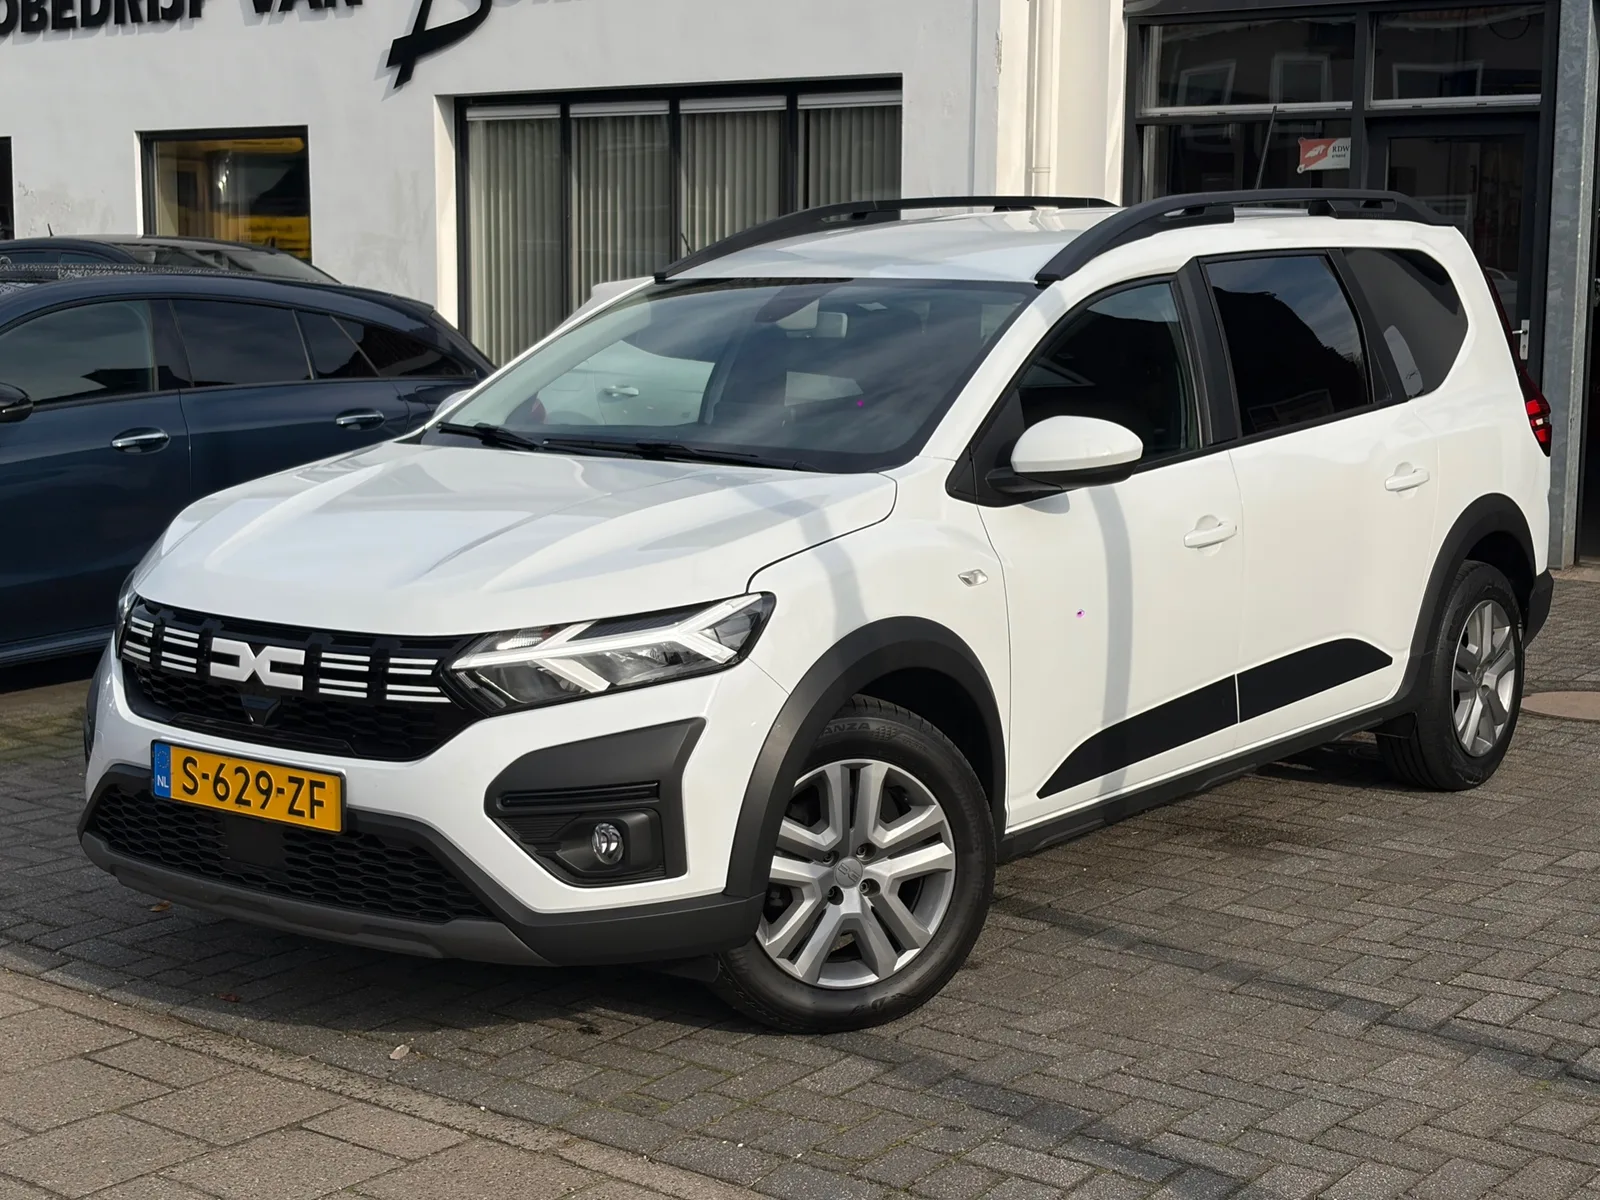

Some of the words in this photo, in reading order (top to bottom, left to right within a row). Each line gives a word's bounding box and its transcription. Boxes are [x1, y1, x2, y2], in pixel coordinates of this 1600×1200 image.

[1332, 144, 1350, 153] RDW
[821, 722, 871, 737] ANZA
[156, 774, 170, 789] NL
[182, 756, 326, 820] S-629-ZF
